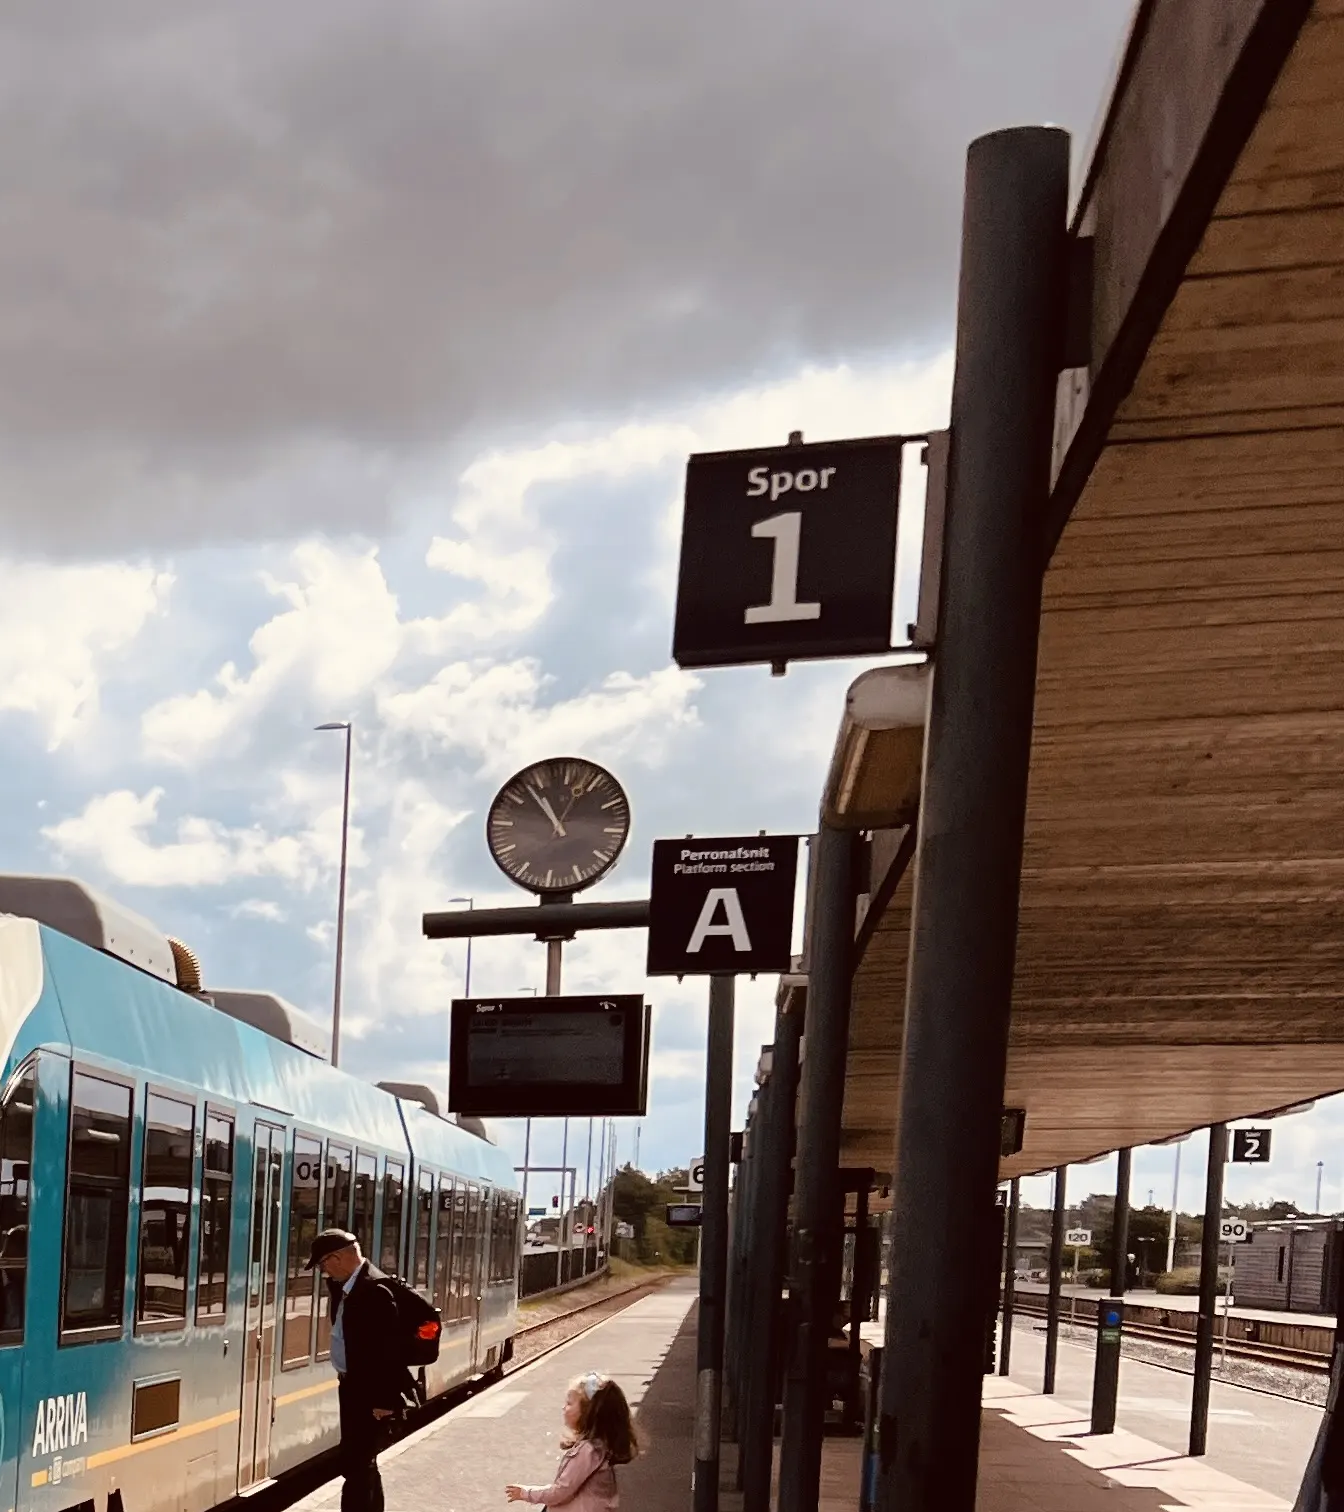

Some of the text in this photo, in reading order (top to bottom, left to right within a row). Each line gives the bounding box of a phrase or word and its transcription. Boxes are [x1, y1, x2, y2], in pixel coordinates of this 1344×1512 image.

[746, 466, 837, 501] Spor
[744, 511, 821, 624] 1
[673, 860, 775, 874] Platform section
[680, 847, 770, 861] Perronafsnit
[685, 888, 753, 953] A
[1244, 1138, 1261, 1158] 2
[1221, 1224, 1244, 1236] 90
[32, 1391, 88, 1458] ARRIVA
